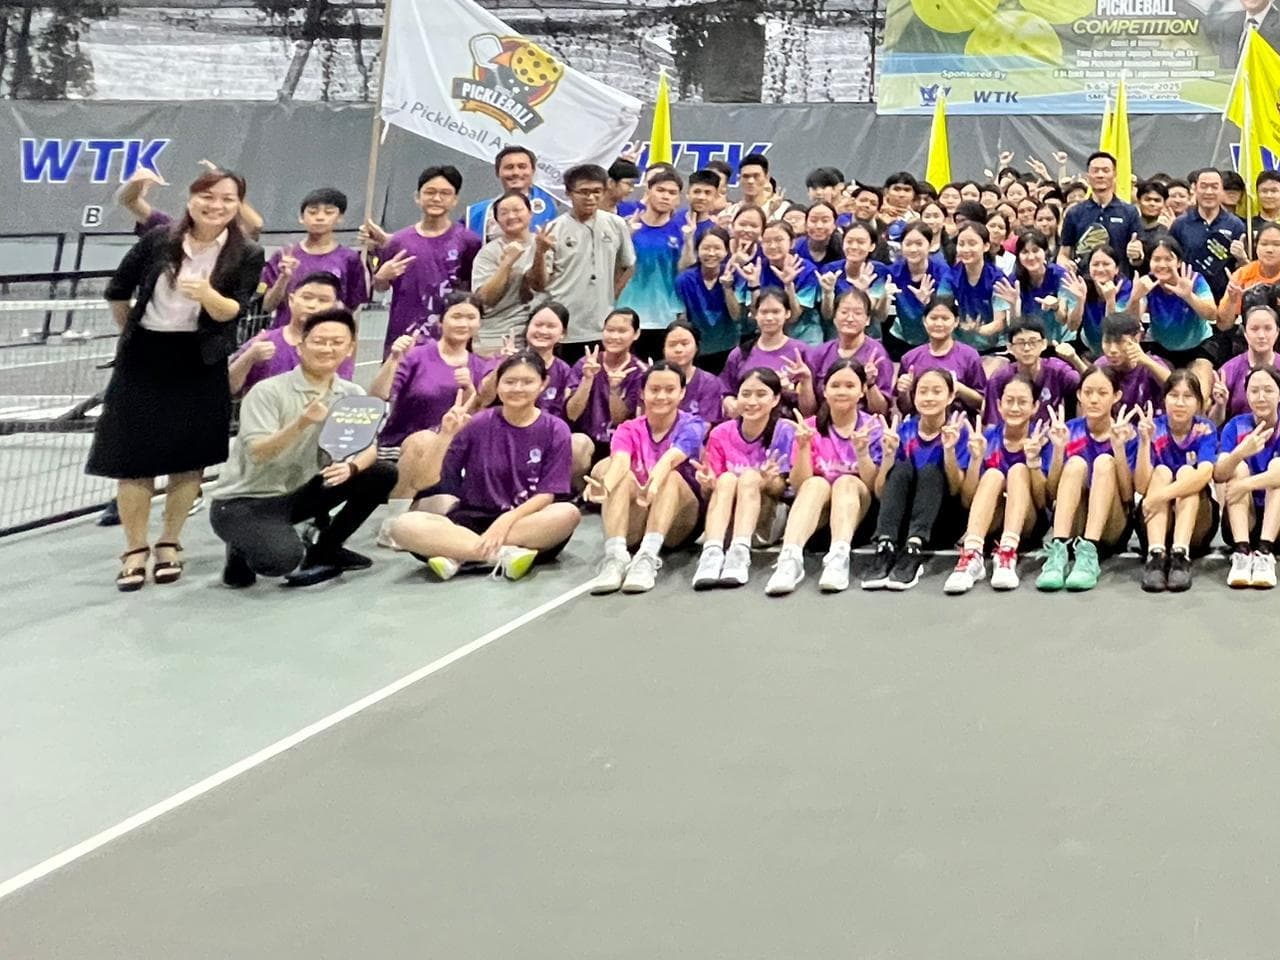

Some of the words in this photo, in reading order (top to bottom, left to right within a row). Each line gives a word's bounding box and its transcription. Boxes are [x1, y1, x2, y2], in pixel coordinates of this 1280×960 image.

[1073, 18, 1200, 35] COMPETITION
[941, 70, 993, 80] Sponsored
[462, 82, 534, 127] PICKLEBALL
[973, 90, 1019, 103] WTK
[410, 101, 489, 144] Pickleball
[20, 138, 171, 184] WTK
[84, 207, 101, 225] B
